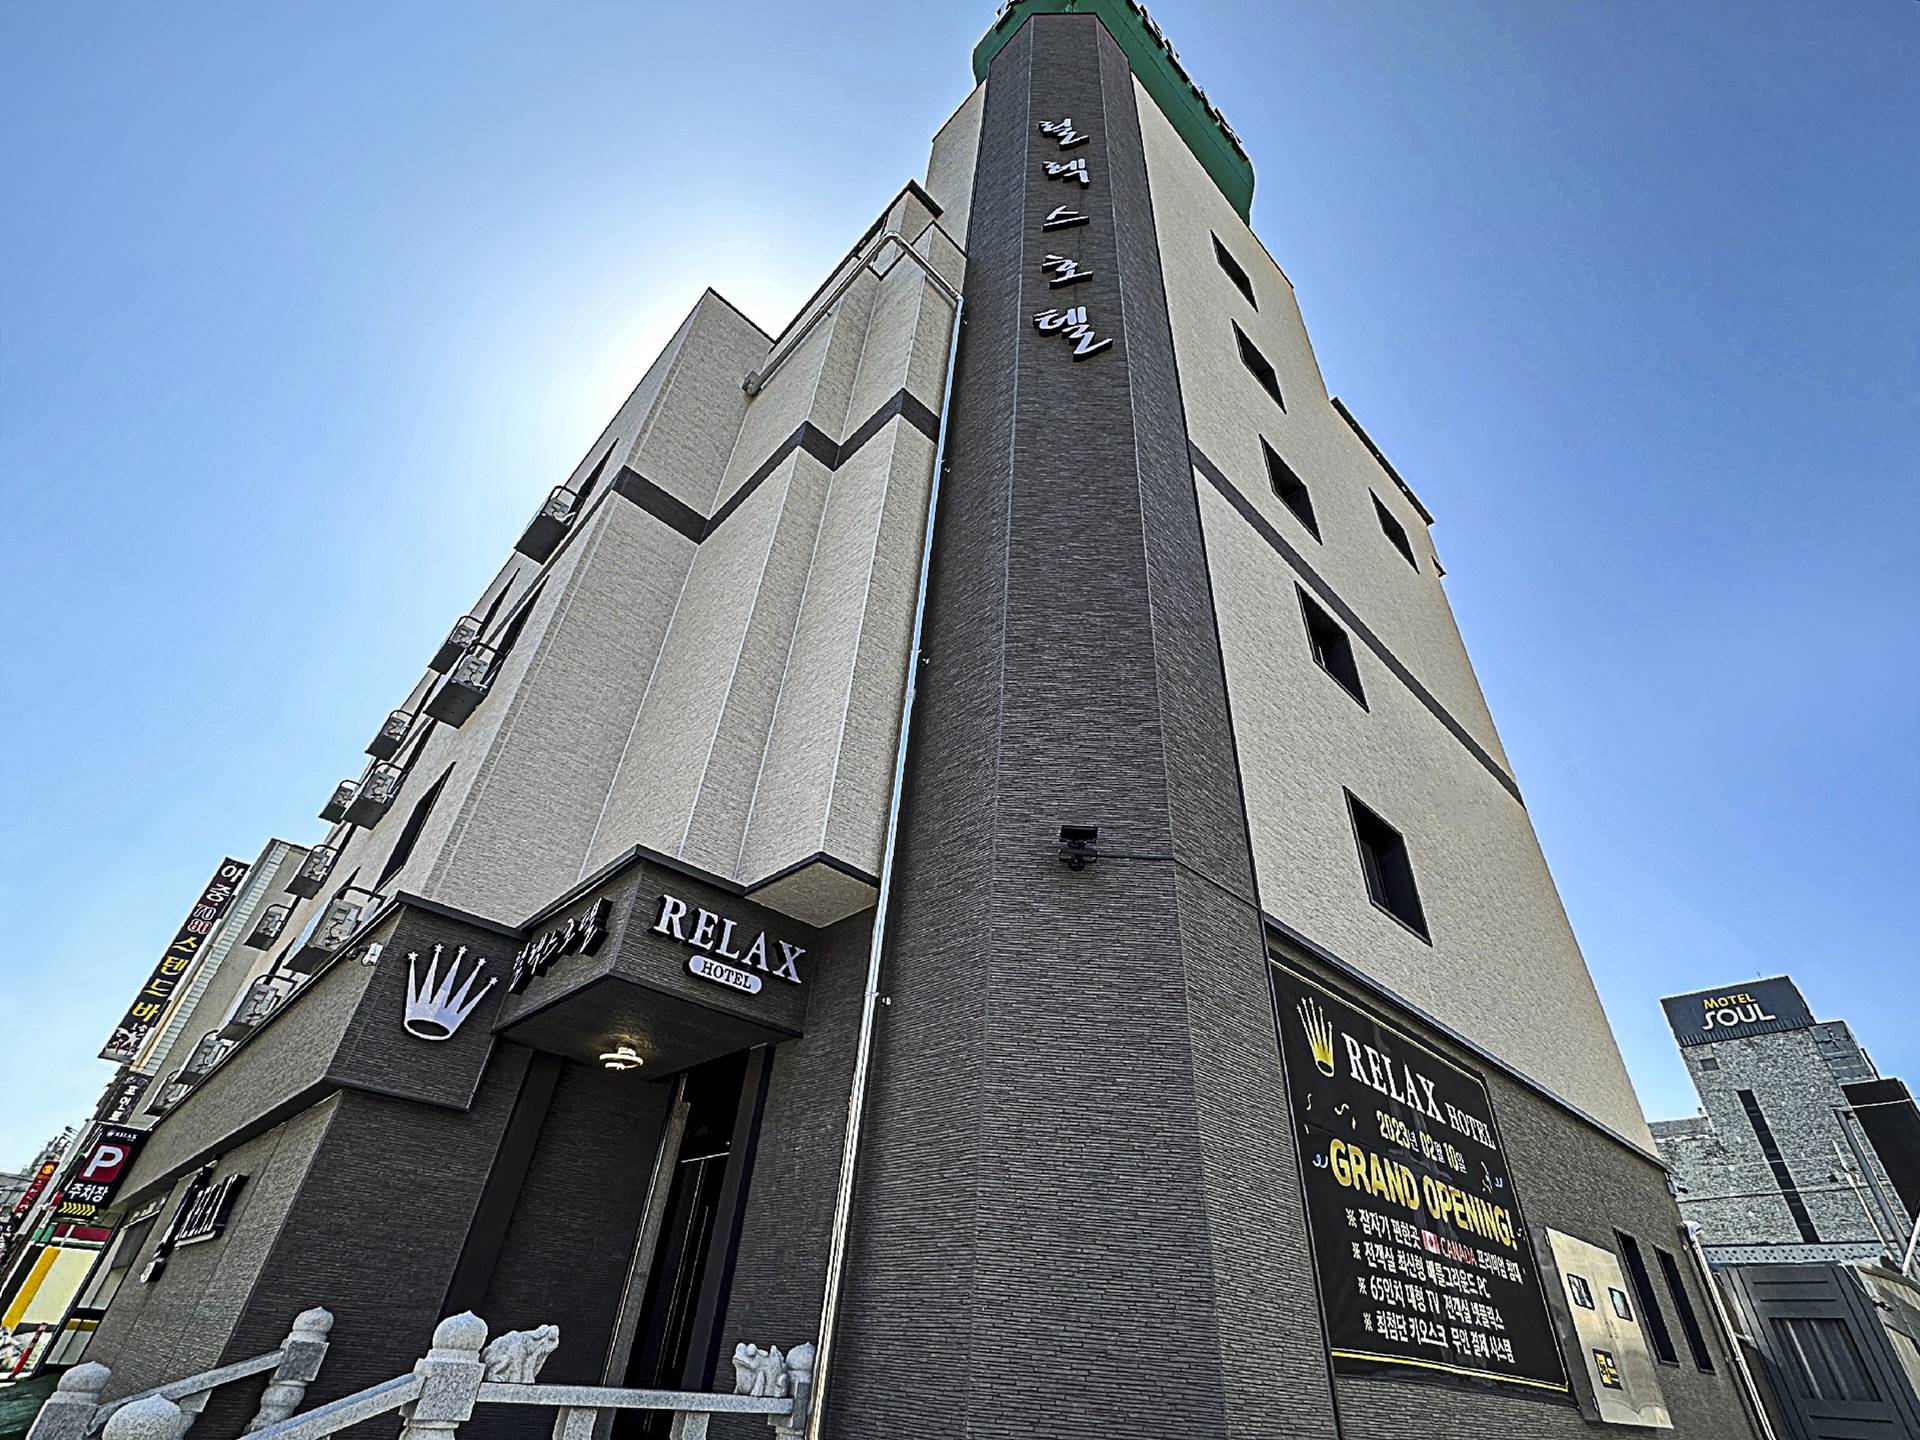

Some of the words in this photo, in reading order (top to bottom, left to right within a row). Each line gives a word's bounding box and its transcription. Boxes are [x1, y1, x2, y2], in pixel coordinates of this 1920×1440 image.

[653, 894, 806, 984] RELAX
[132, 936, 198, 1023] 스텐드바
[701, 961, 752, 990] HOTEL
[1703, 993, 1756, 1010] MOTEL
[1702, 1003, 1776, 1031] SOUL
[1341, 1032, 1447, 1125] RELAX
[1444, 1102, 1497, 1151] HOTEL
[83, 1145, 124, 1178] P
[1376, 1110, 1420, 1153] 2023년
[1419, 1130, 1446, 1164] 02월
[1443, 1142, 1468, 1174] 10일
[68, 1182, 109, 1203] 주차장
[1329, 1138, 1420, 1211] GRAND
[1422, 1174, 1518, 1252] OPENING!
[1358, 1208, 1392, 1241] 잠자기
[1390, 1218, 1421, 1250] 편한곳
[1440, 1236, 1478, 1268] CANADA
[1476, 1249, 1508, 1280] 프리미엄
[1363, 1241, 1397, 1273] 전객실
[1396, 1249, 1427, 1282] 최신형
[1425, 1259, 1479, 1295] 배틀그라운드
[1476, 1275, 1492, 1299] PC
[1370, 1275, 1406, 1308] 65인치
[1404, 1283, 1427, 1313] 대형
[1425, 1289, 1441, 1315] TV
[1442, 1294, 1473, 1324] 전객실
[1470, 1301, 1505, 1331] 넷플릭스
[1376, 1310, 1409, 1343] 최첨단
[1408, 1317, 1449, 1348] 키오스크
[1450, 1326, 1472, 1355] 무인
[1488, 1335, 1516, 1364] 시스템
